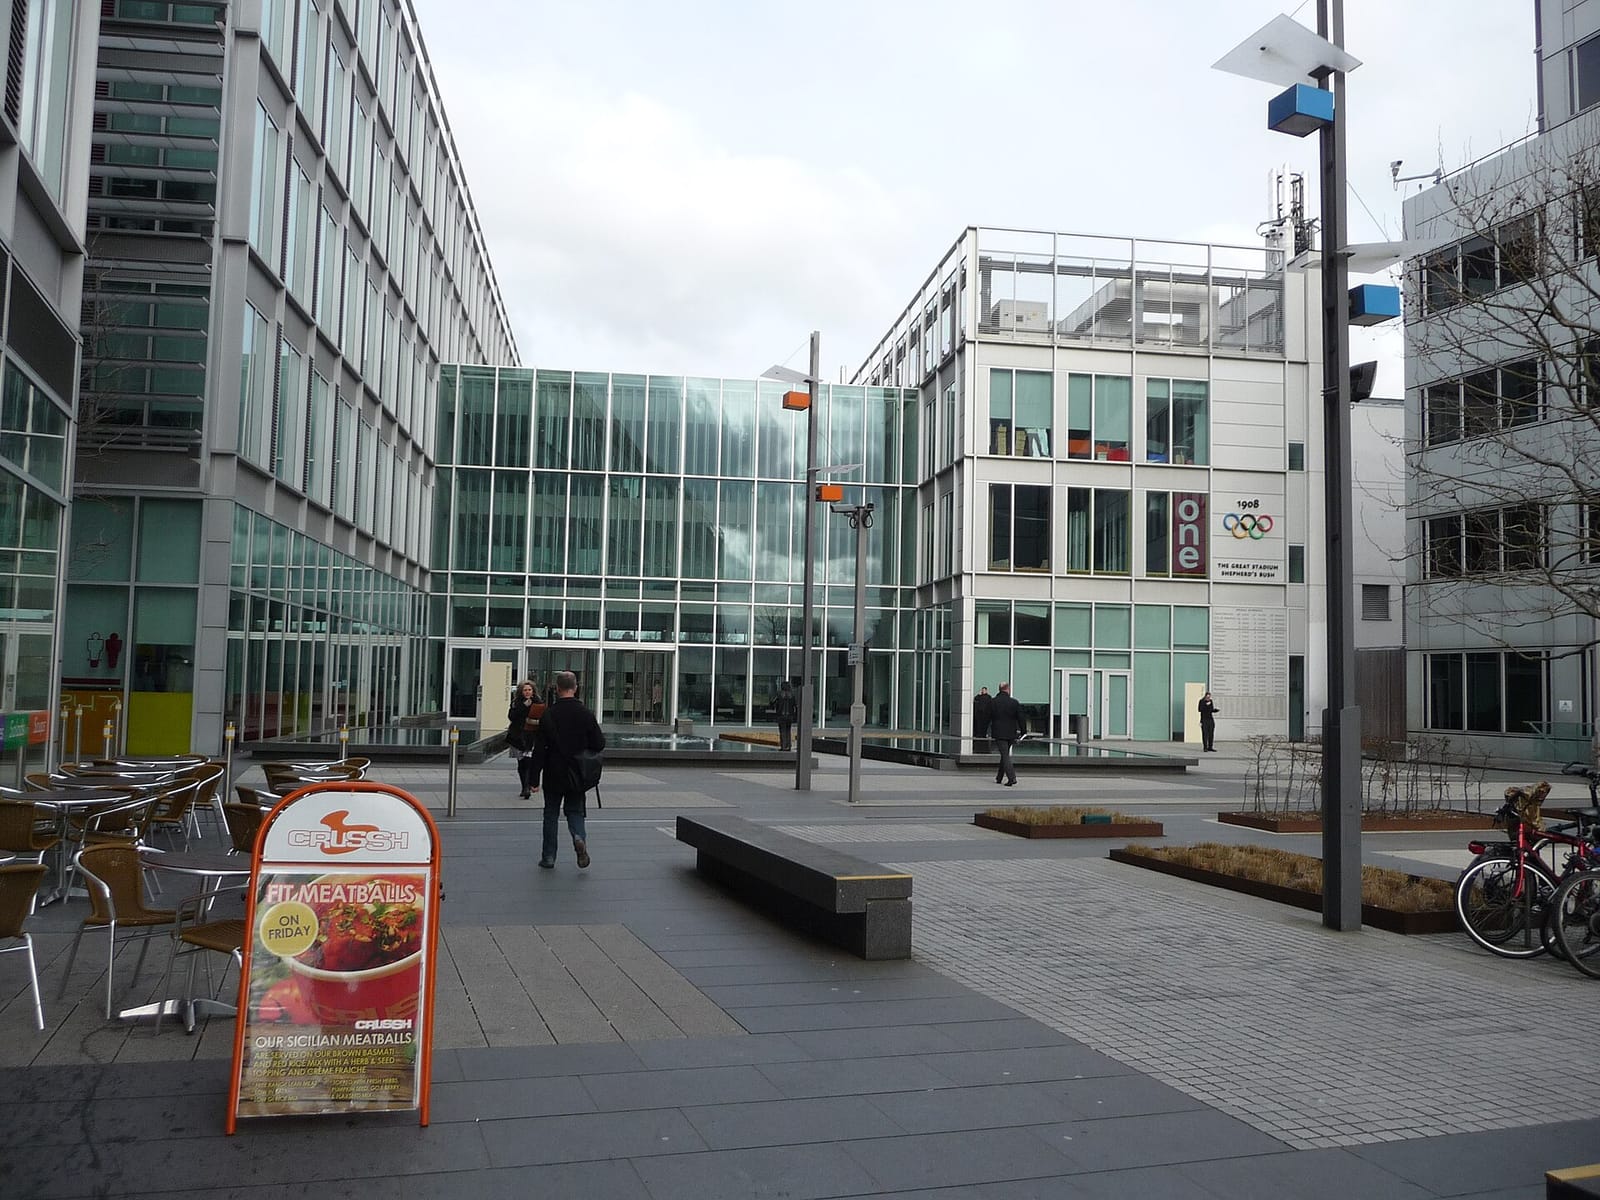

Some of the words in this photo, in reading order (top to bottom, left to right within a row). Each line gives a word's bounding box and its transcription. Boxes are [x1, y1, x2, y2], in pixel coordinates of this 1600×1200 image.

[1237, 499, 1260, 510] 1908
[1178, 499, 1200, 569] one
[1221, 570, 1257, 578] SHEPHERD'S
[288, 830, 409, 851] CRUSSH
[266, 884, 295, 904] FIT
[297, 883, 417, 905] MEATBALLS
[279, 914, 300, 927] ON
[268, 925, 311, 940] FRIDAY
[354, 1019, 413, 1030] CRUSSH
[255, 1035, 284, 1049] OUR
[286, 1034, 340, 1048] SICILIAN
[342, 1032, 412, 1046] MEATBALLS
[254, 1051, 271, 1060] ARE
[272, 1050, 299, 1059] SERVED
[300, 1050, 313, 1058] ON
[314, 1049, 331, 1058] OUR
[332, 1049, 361, 1057] BROWN
[362, 1048, 395, 1056] BASMATI
[253, 1060, 272, 1069] AND
[273, 1060, 288, 1068] RED
[307, 1059, 323, 1067] MIX
[324, 1058, 342, 1066] WITH
[351, 1057, 369, 1065] HERB
[377, 1057, 395, 1065] SEED
[252, 1068, 288, 1078] TOPPING
[288, 1068, 306, 1077] AND
